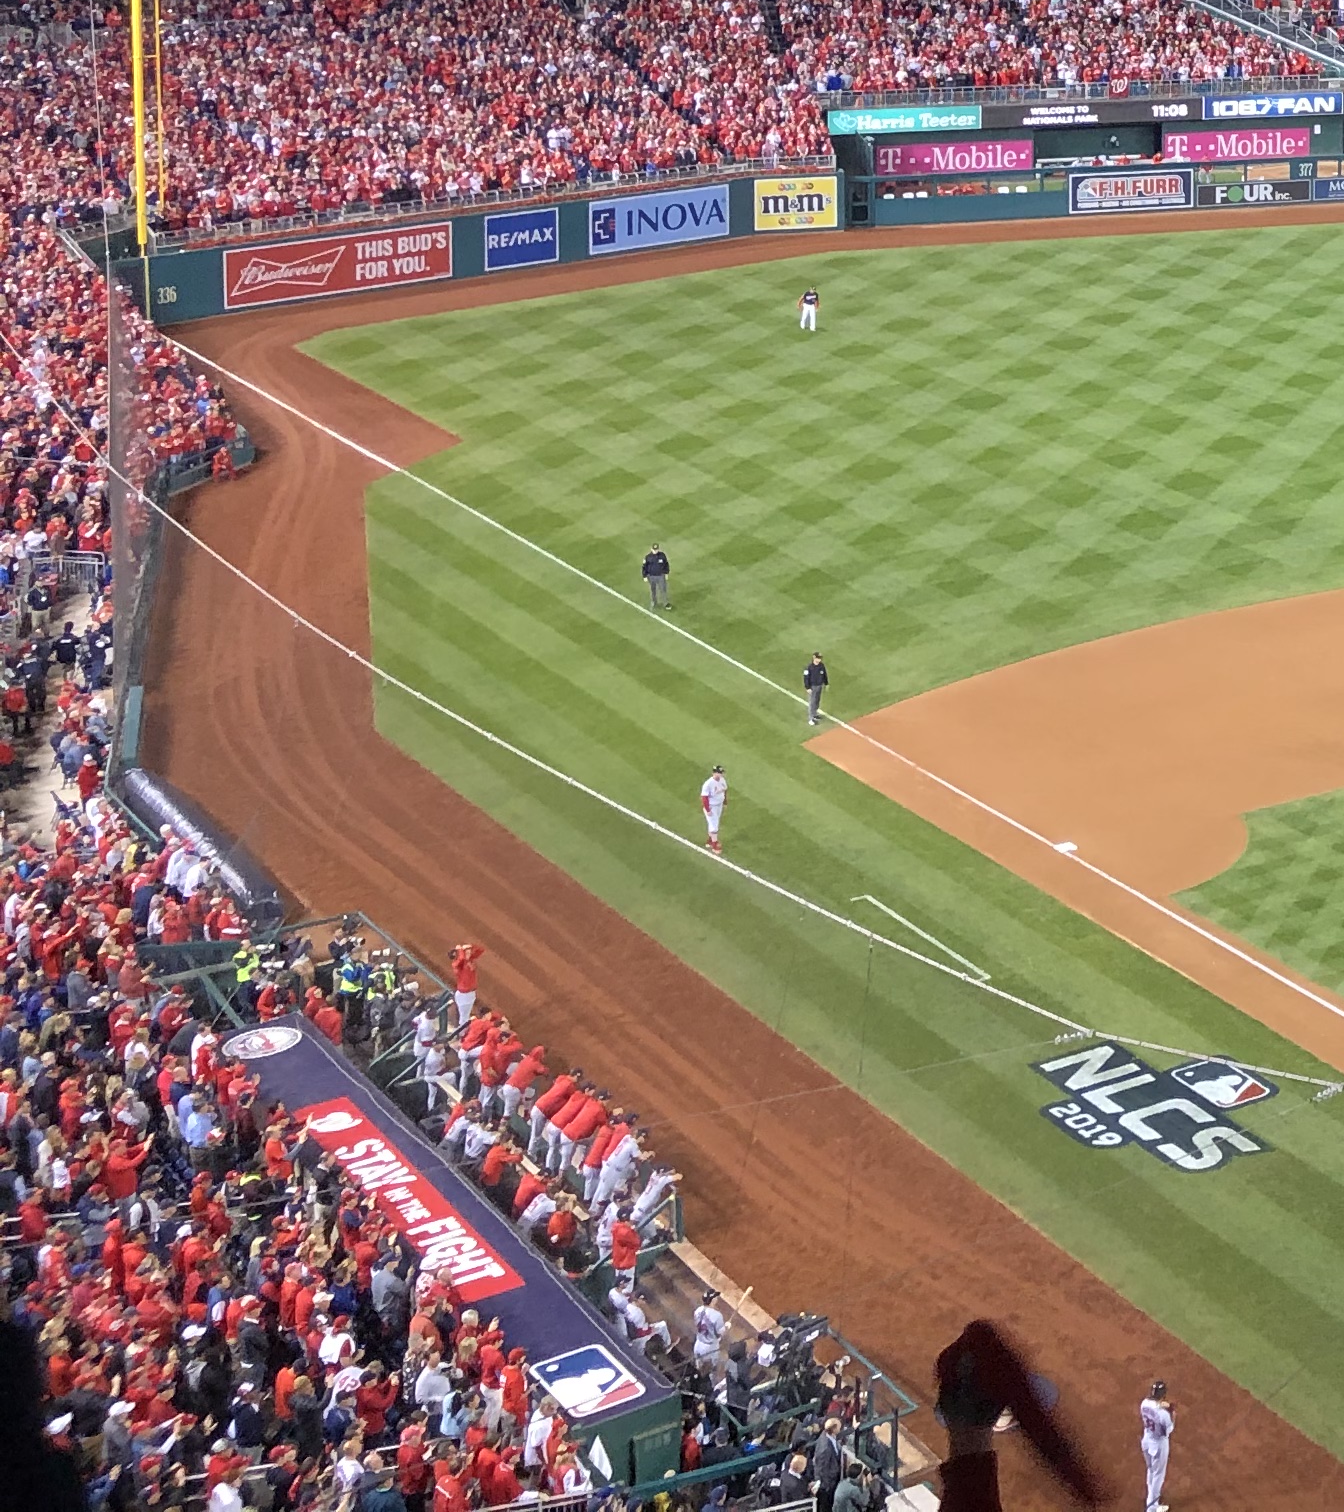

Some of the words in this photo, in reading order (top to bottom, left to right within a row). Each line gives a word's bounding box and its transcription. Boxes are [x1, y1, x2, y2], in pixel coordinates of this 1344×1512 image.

[1031, 106, 1075, 116] WELCOME
[1077, 105, 1089, 114] TO
[1151, 104, 1188, 118] 11:08
[1275, 96, 1336, 114] FAN
[857, 115, 914, 131] Harris
[919, 112, 976, 129] Teeter
[1022, 115, 1074, 126] NATIONALS
[1075, 114, 1098, 124] PARK
[1299, 163, 1313, 177] 377
[1215, 184, 1273, 205] FOUR
[627, 198, 726, 236] INOVA
[355, 237, 393, 260] THIS
[398, 231, 447, 254] BUD'S
[488, 226, 554, 249] RE/MAX
[241, 260, 334, 285] Budweiser
[355, 261, 389, 281] FOR
[392, 255, 430, 276] YOU.
[157, 285, 177, 305] 336
[1040, 1045, 1261, 1170] NLCS
[1049, 1103, 1122, 1146] 2019
[335, 1138, 417, 1191] STAY
[383, 1185, 407, 1203] IN
[396, 1198, 432, 1224] THE
[406, 1215, 506, 1286] FIGHT
